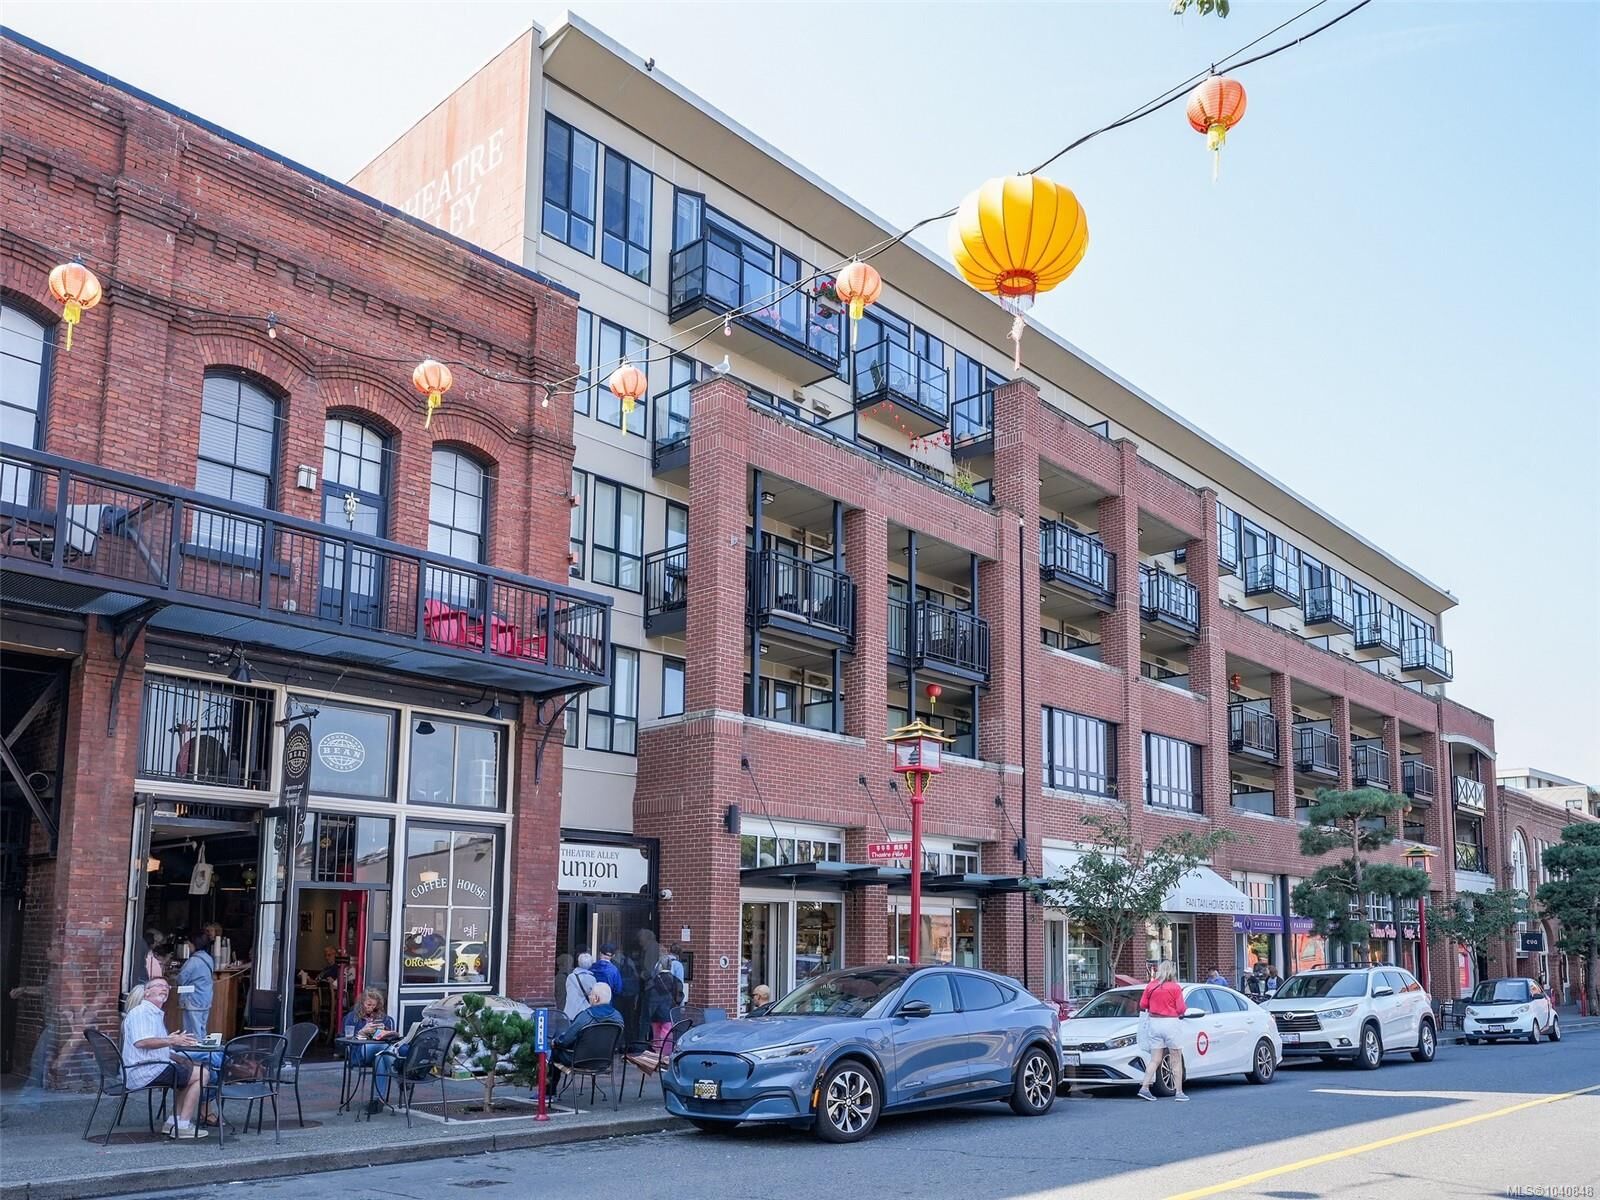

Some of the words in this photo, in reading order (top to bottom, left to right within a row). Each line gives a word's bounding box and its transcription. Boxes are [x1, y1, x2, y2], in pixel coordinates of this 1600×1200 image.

[400, 128, 504, 218] HEATRE
[323, 747, 361, 758] BEAN
[561, 848, 596, 858] THEATRE
[597, 851, 620, 860] ALLEY
[411, 878, 448, 898] COFFEE
[456, 879, 488, 900] HOUSE
[582, 880, 597, 888] 517
